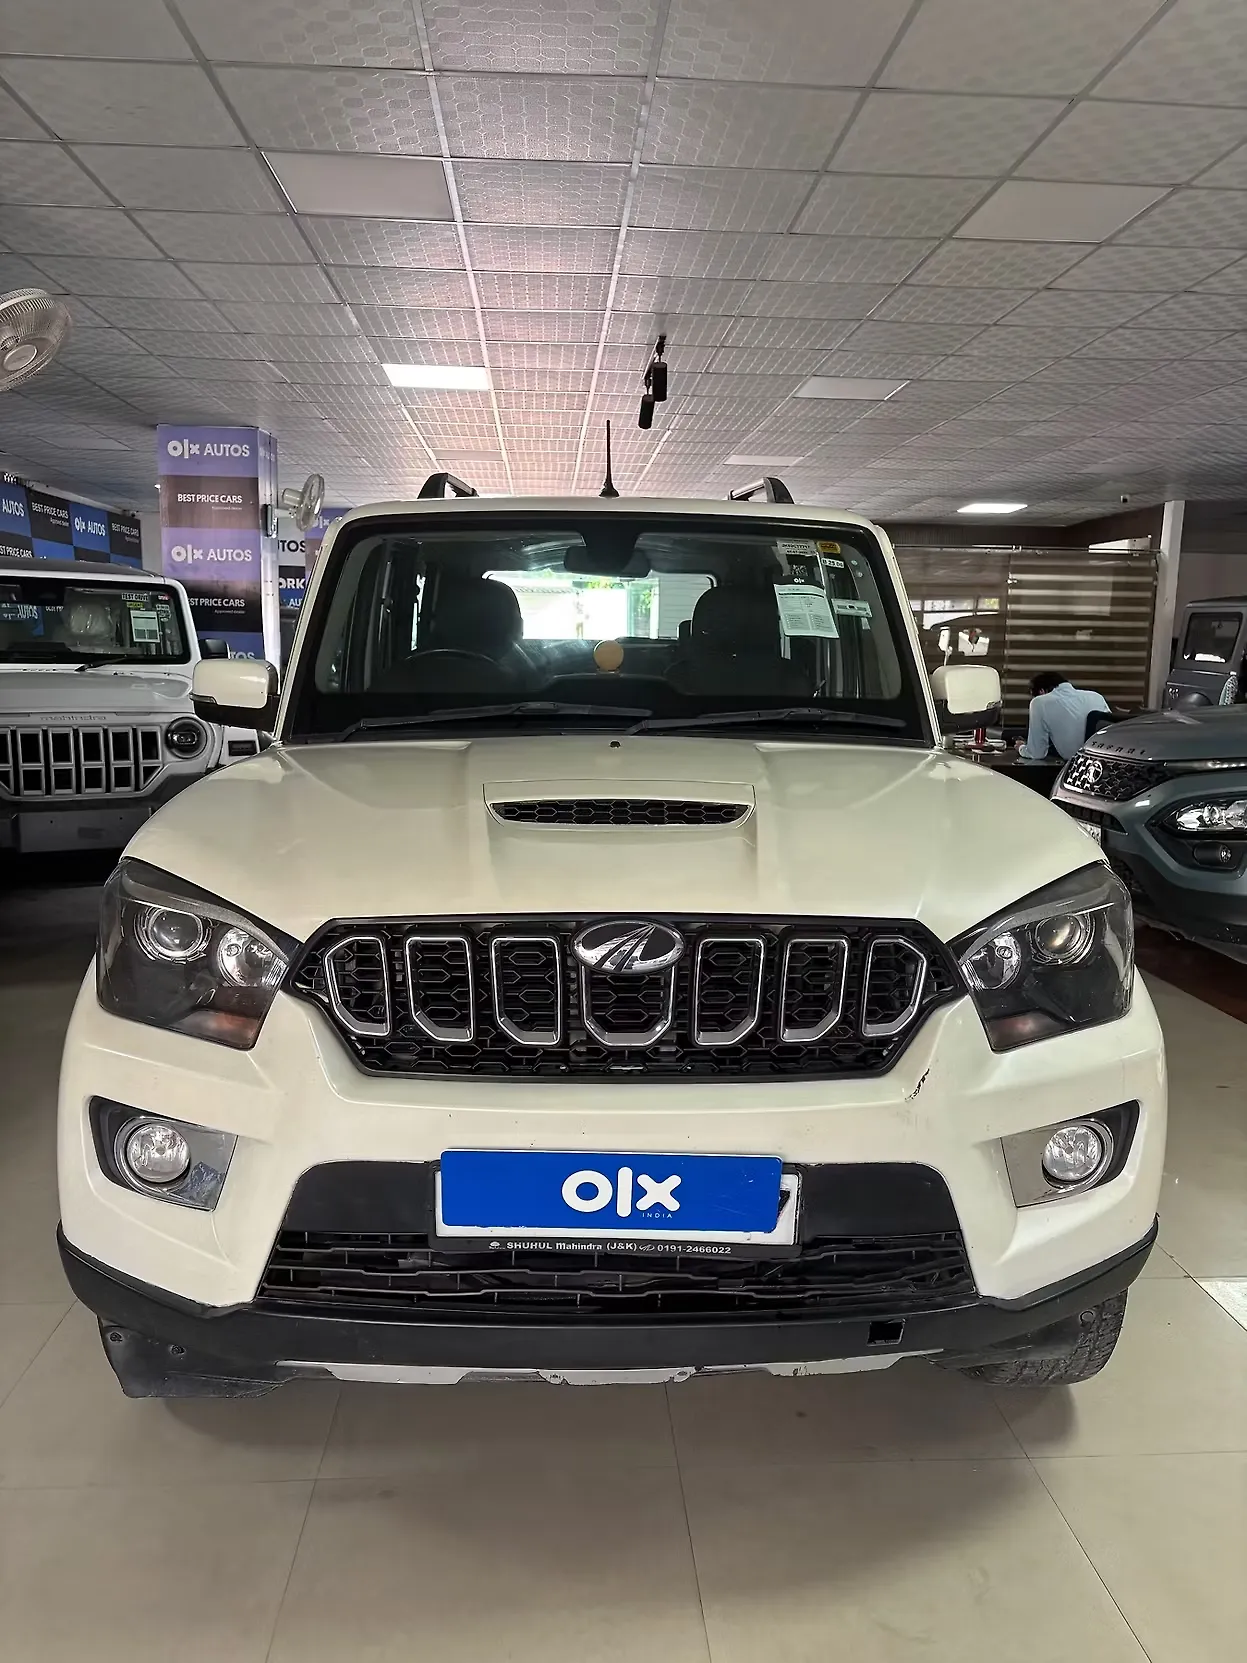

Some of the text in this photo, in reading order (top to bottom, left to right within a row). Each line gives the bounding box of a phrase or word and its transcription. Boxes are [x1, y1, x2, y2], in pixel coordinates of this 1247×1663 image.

[204, 443, 250, 457] AUTOS
[177, 493, 243, 504] BEST PRICE CARS
[2, 499, 25, 517] AUTOS
[87, 521, 106, 536] AUTOS
[6, 547, 20, 557] PRICE
[207, 549, 252, 562] AUTOS
[199, 598, 222, 606] PRICE
[222, 599, 245, 607] CARS
[506, 1241, 553, 1250] SHUHUL
[556, 1242, 602, 1250] Mahindra
[606, 1242, 637, 1252] (J&K)
[657, 1244, 732, 1254] 0191-2466022
